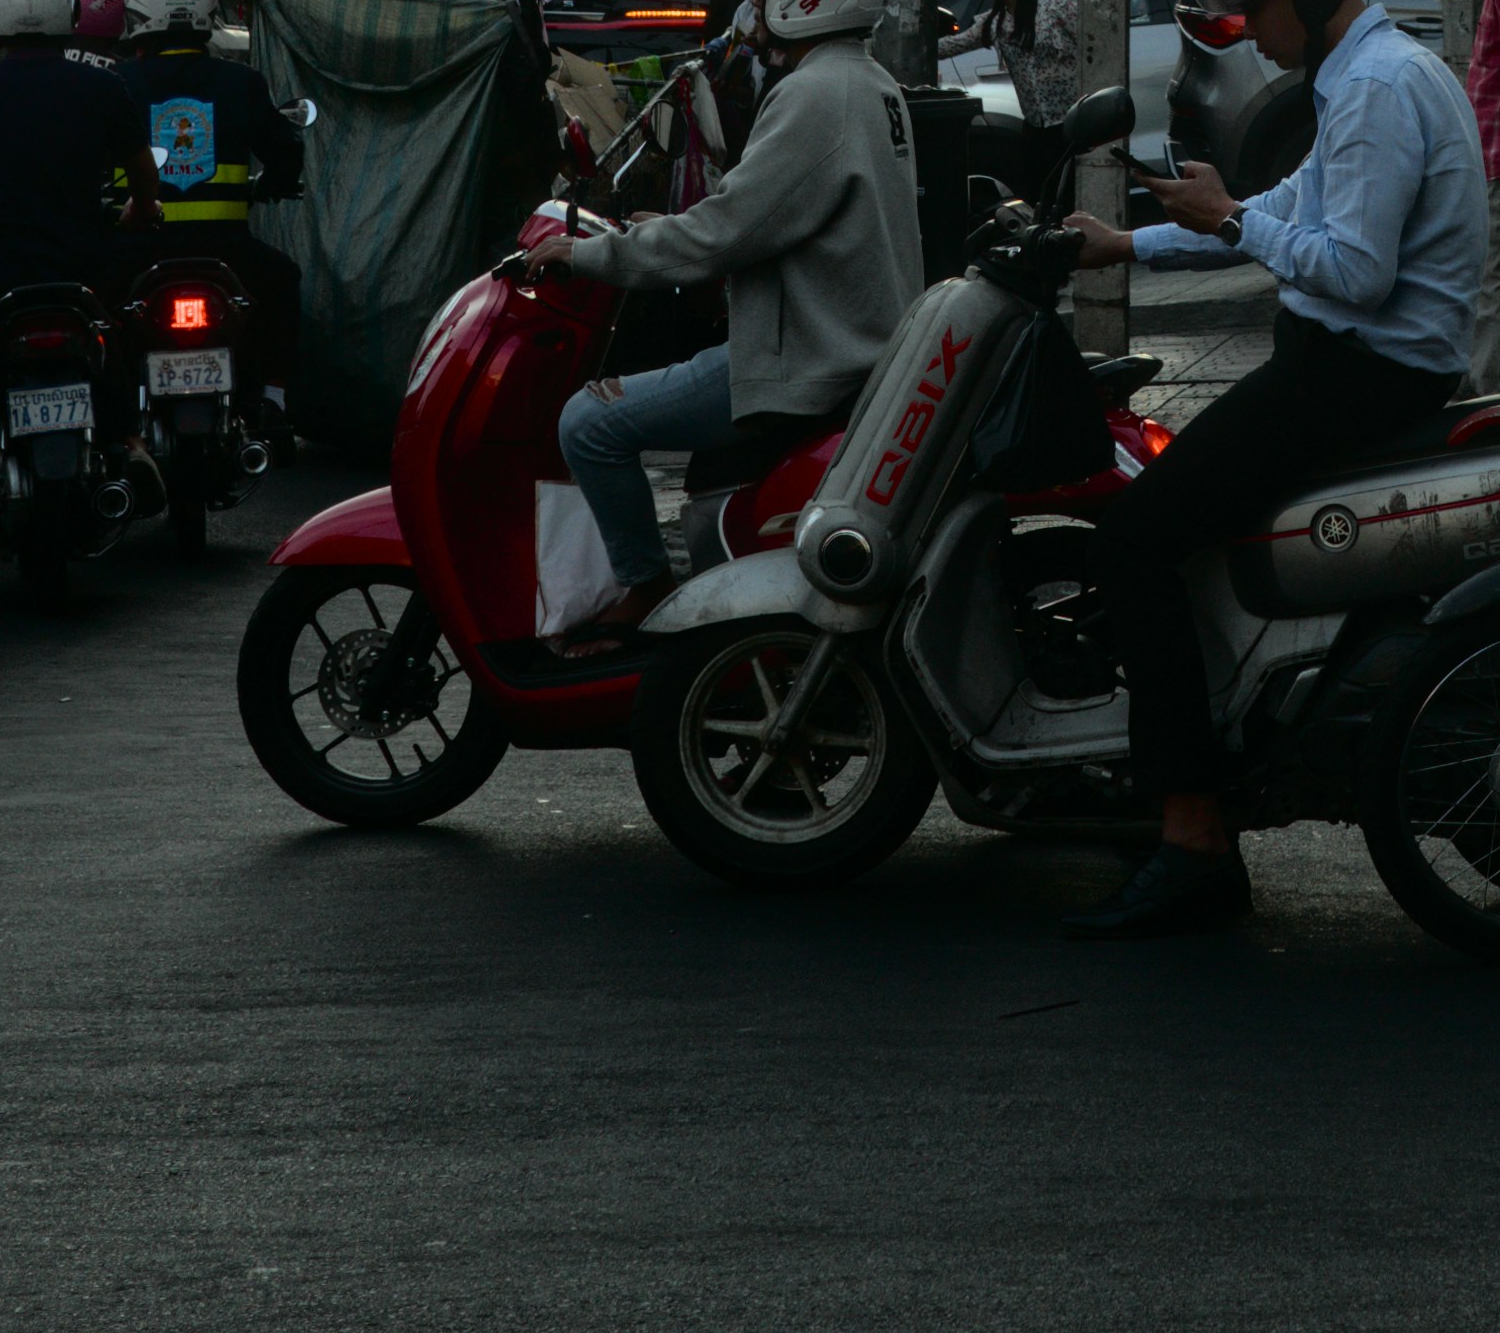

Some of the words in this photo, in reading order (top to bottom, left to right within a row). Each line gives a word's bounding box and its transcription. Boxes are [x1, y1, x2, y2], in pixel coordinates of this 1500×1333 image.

[163, 164, 204, 176] H.M.S
[157, 367, 224, 388] 1P-6722
[11, 401, 90, 429] 1A-8777
[865, 323, 979, 507] QBIX
